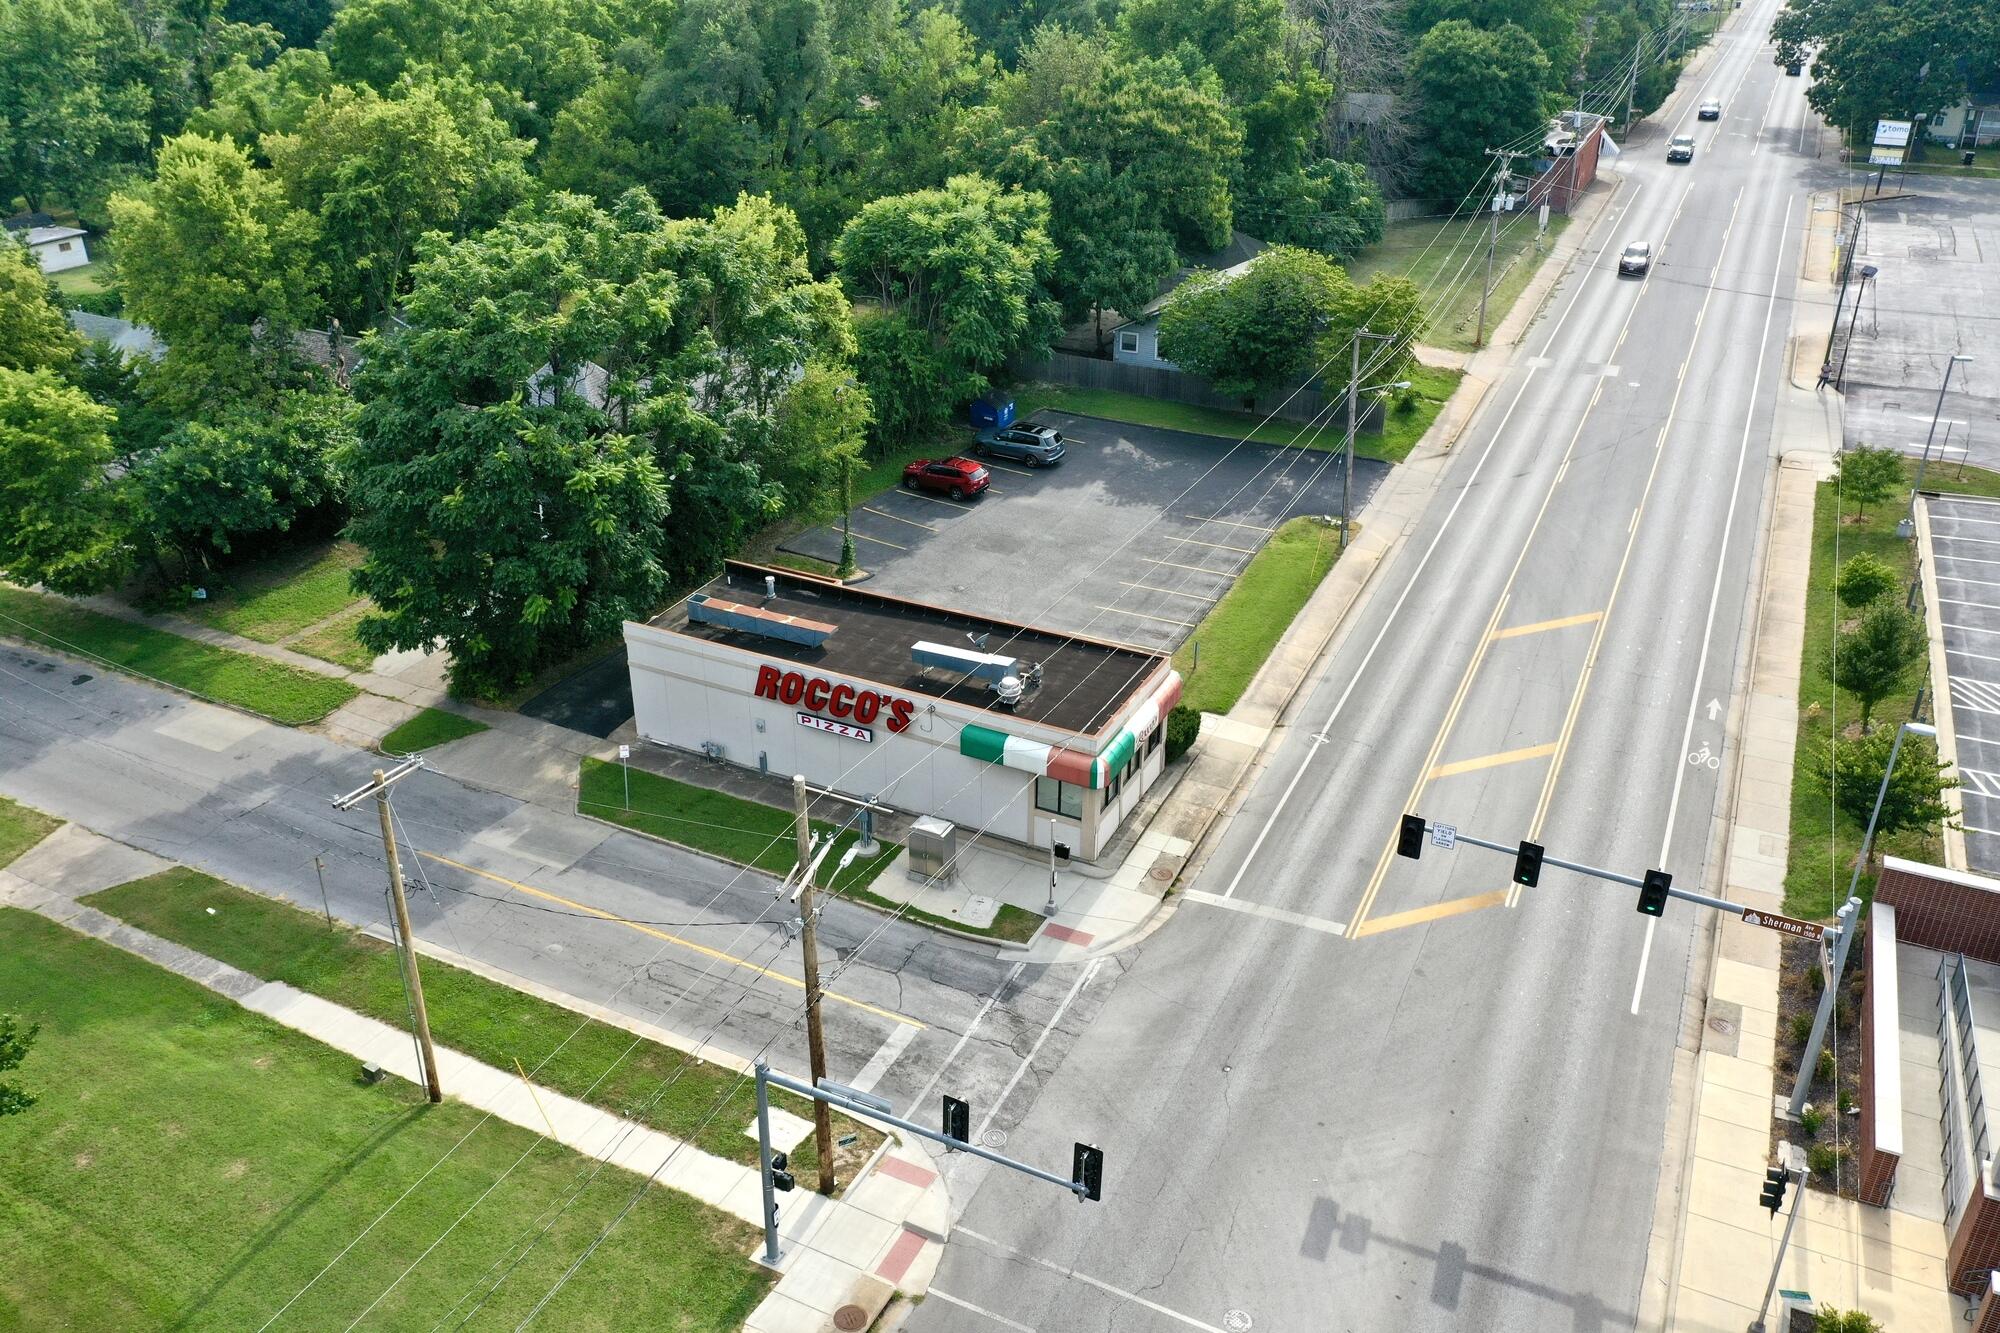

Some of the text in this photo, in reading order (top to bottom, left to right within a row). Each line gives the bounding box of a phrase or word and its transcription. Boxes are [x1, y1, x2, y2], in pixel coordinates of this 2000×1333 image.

[754, 664, 914, 733] ROCCO'S
[801, 716, 866, 739] PIZZA
[1763, 916, 1802, 933] Sherman
